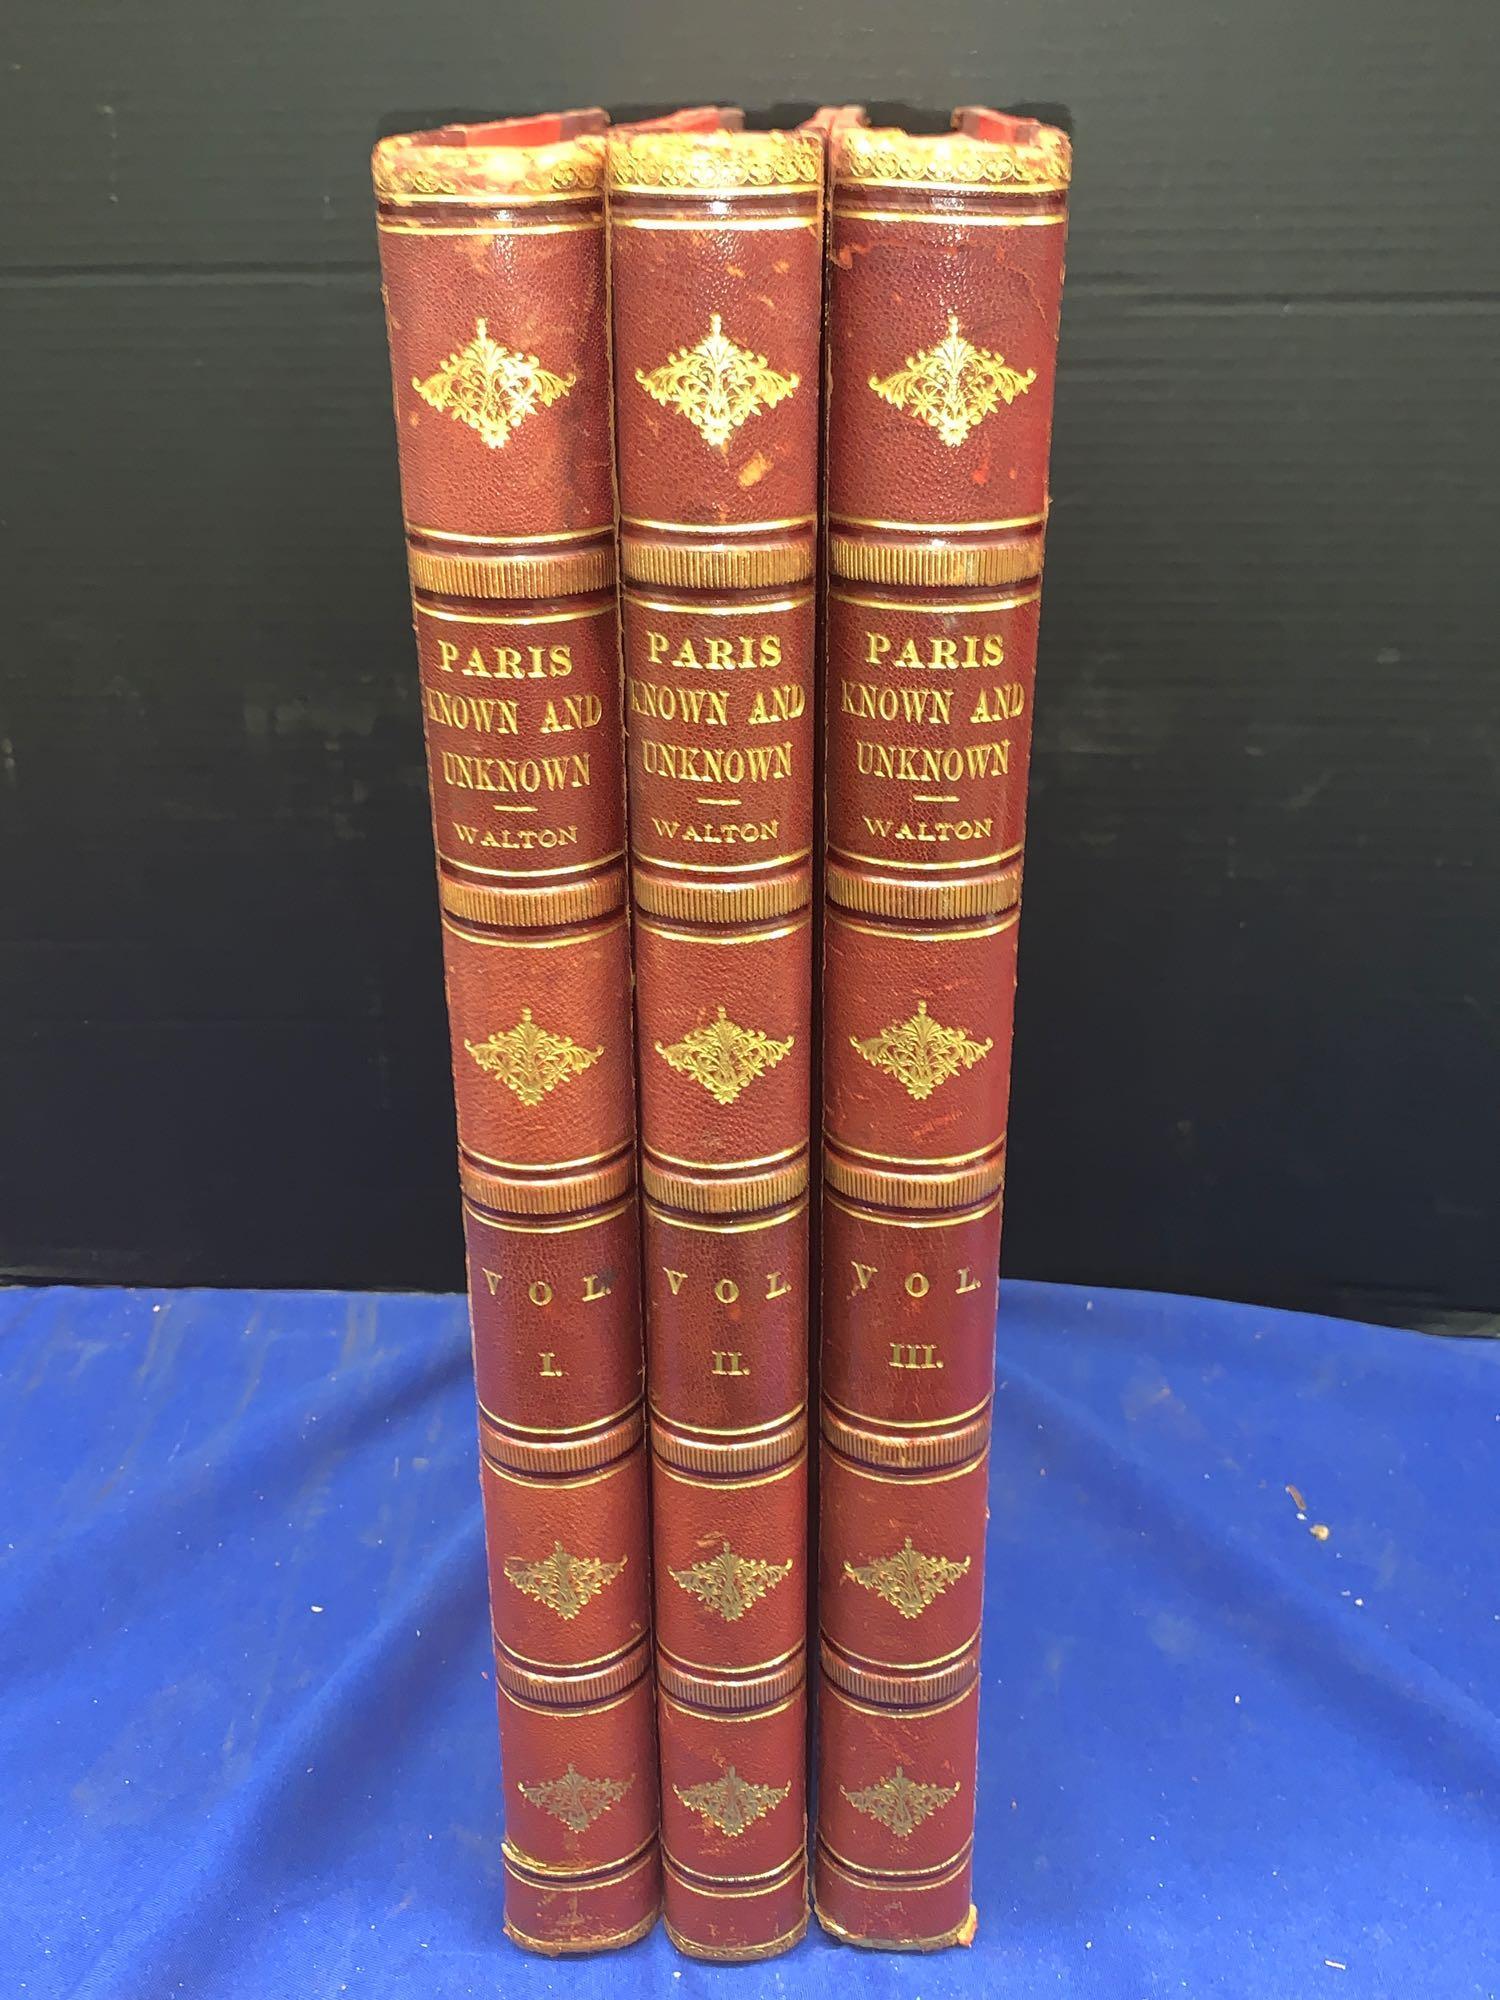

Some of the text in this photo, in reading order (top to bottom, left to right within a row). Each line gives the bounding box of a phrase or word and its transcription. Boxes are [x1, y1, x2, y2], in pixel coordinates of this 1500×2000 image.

[438, 639, 573, 679] PARIS
[647, 630, 782, 670] PARIS
[866, 631, 1004, 670] PARIS
[426, 687, 602, 735] KNOWN AND
[629, 677, 805, 726] KNOWN AND
[841, 678, 1025, 724] KNOWN AND
[442, 751, 590, 792] UNKNOWN
[642, 740, 794, 784] UNKNOWN
[856, 739, 1011, 782] UNKNOWN
[453, 822, 577, 849] WALTON
[651, 817, 779, 844] WALTON
[862, 815, 993, 842] WALTON
[538, 1352, 563, 1376] I.
[711, 1351, 750, 1376] II.
[889, 1342, 944, 1369] III.
